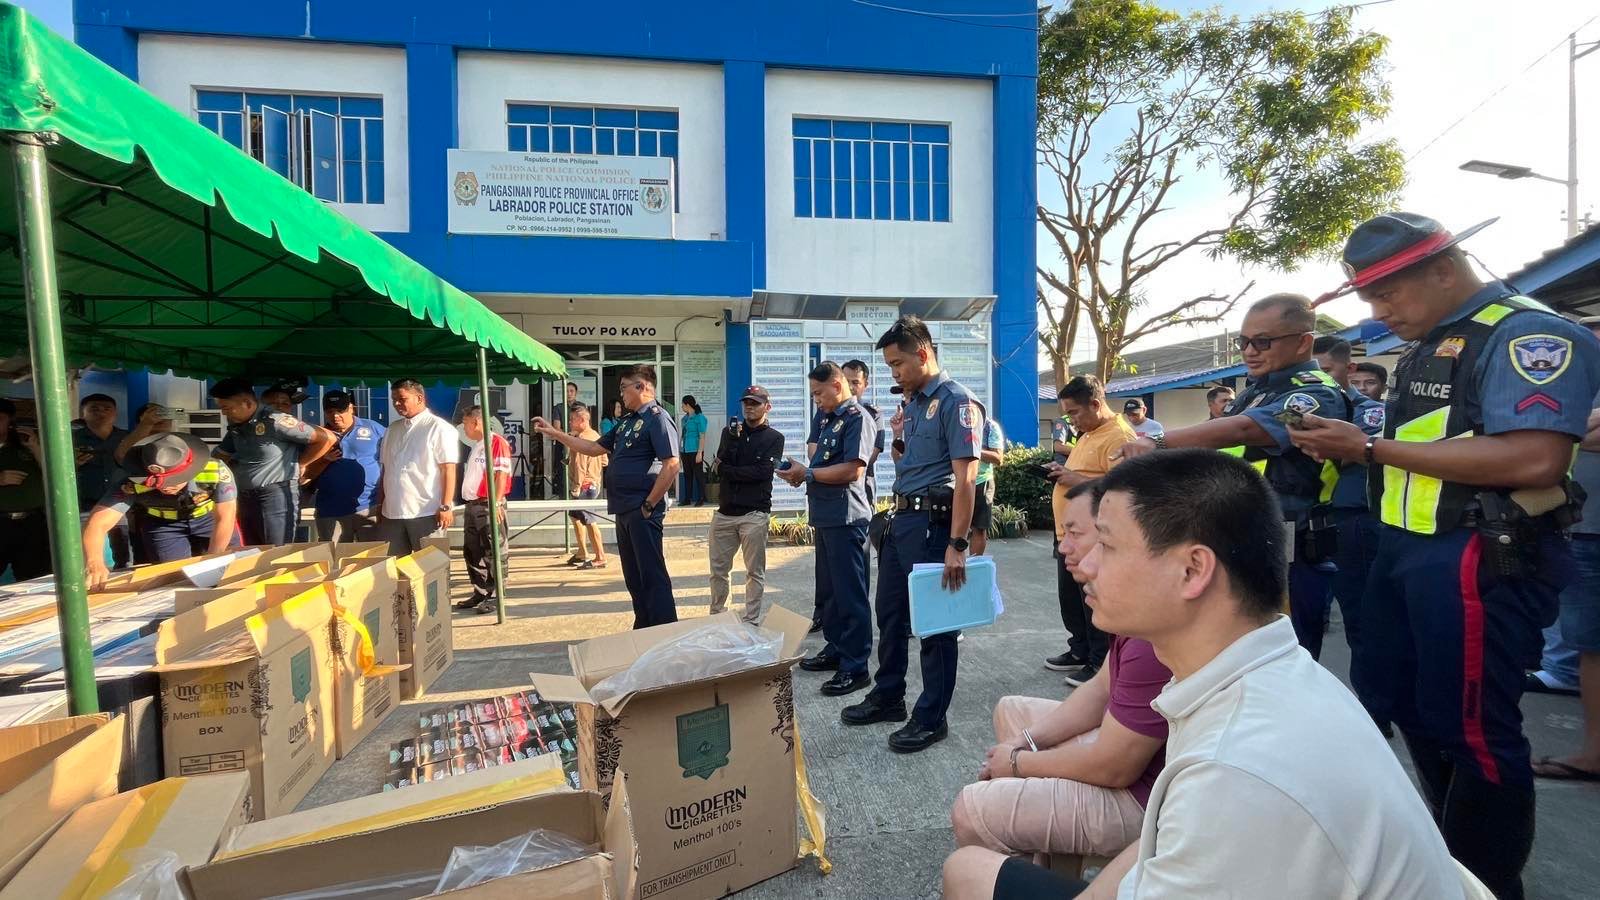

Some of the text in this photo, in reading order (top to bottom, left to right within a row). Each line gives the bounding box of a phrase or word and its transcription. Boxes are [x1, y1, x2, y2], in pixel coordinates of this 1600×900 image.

[523, 155, 551, 163] Republic
[490, 164, 539, 174] NATIONAL
[541, 166, 573, 174] POLICE
[486, 172, 637, 186] PHILIPPINE NATIONAL POLICE
[480, 184, 639, 202] PANGASINAN POLICE PROVINCIAL OFFICE
[489, 199, 633, 216] LABRADOR POLICE STATION
[514, 214, 546, 222] Poblacion,
[547, 216, 576, 224] Labrador,
[552, 326, 657, 336] TULOY PO KAYO
[1409, 381, 1452, 399] POLICE
[174, 680, 244, 701] MODERN
[198, 726, 224, 736] BOX
[665, 785, 747, 830] MODERN
[681, 802, 743, 831] CIGARETTES
[673, 819, 742, 851] Menthol 100's
[642, 853, 732, 897] FOR TRANSHIPMENT ONLY
